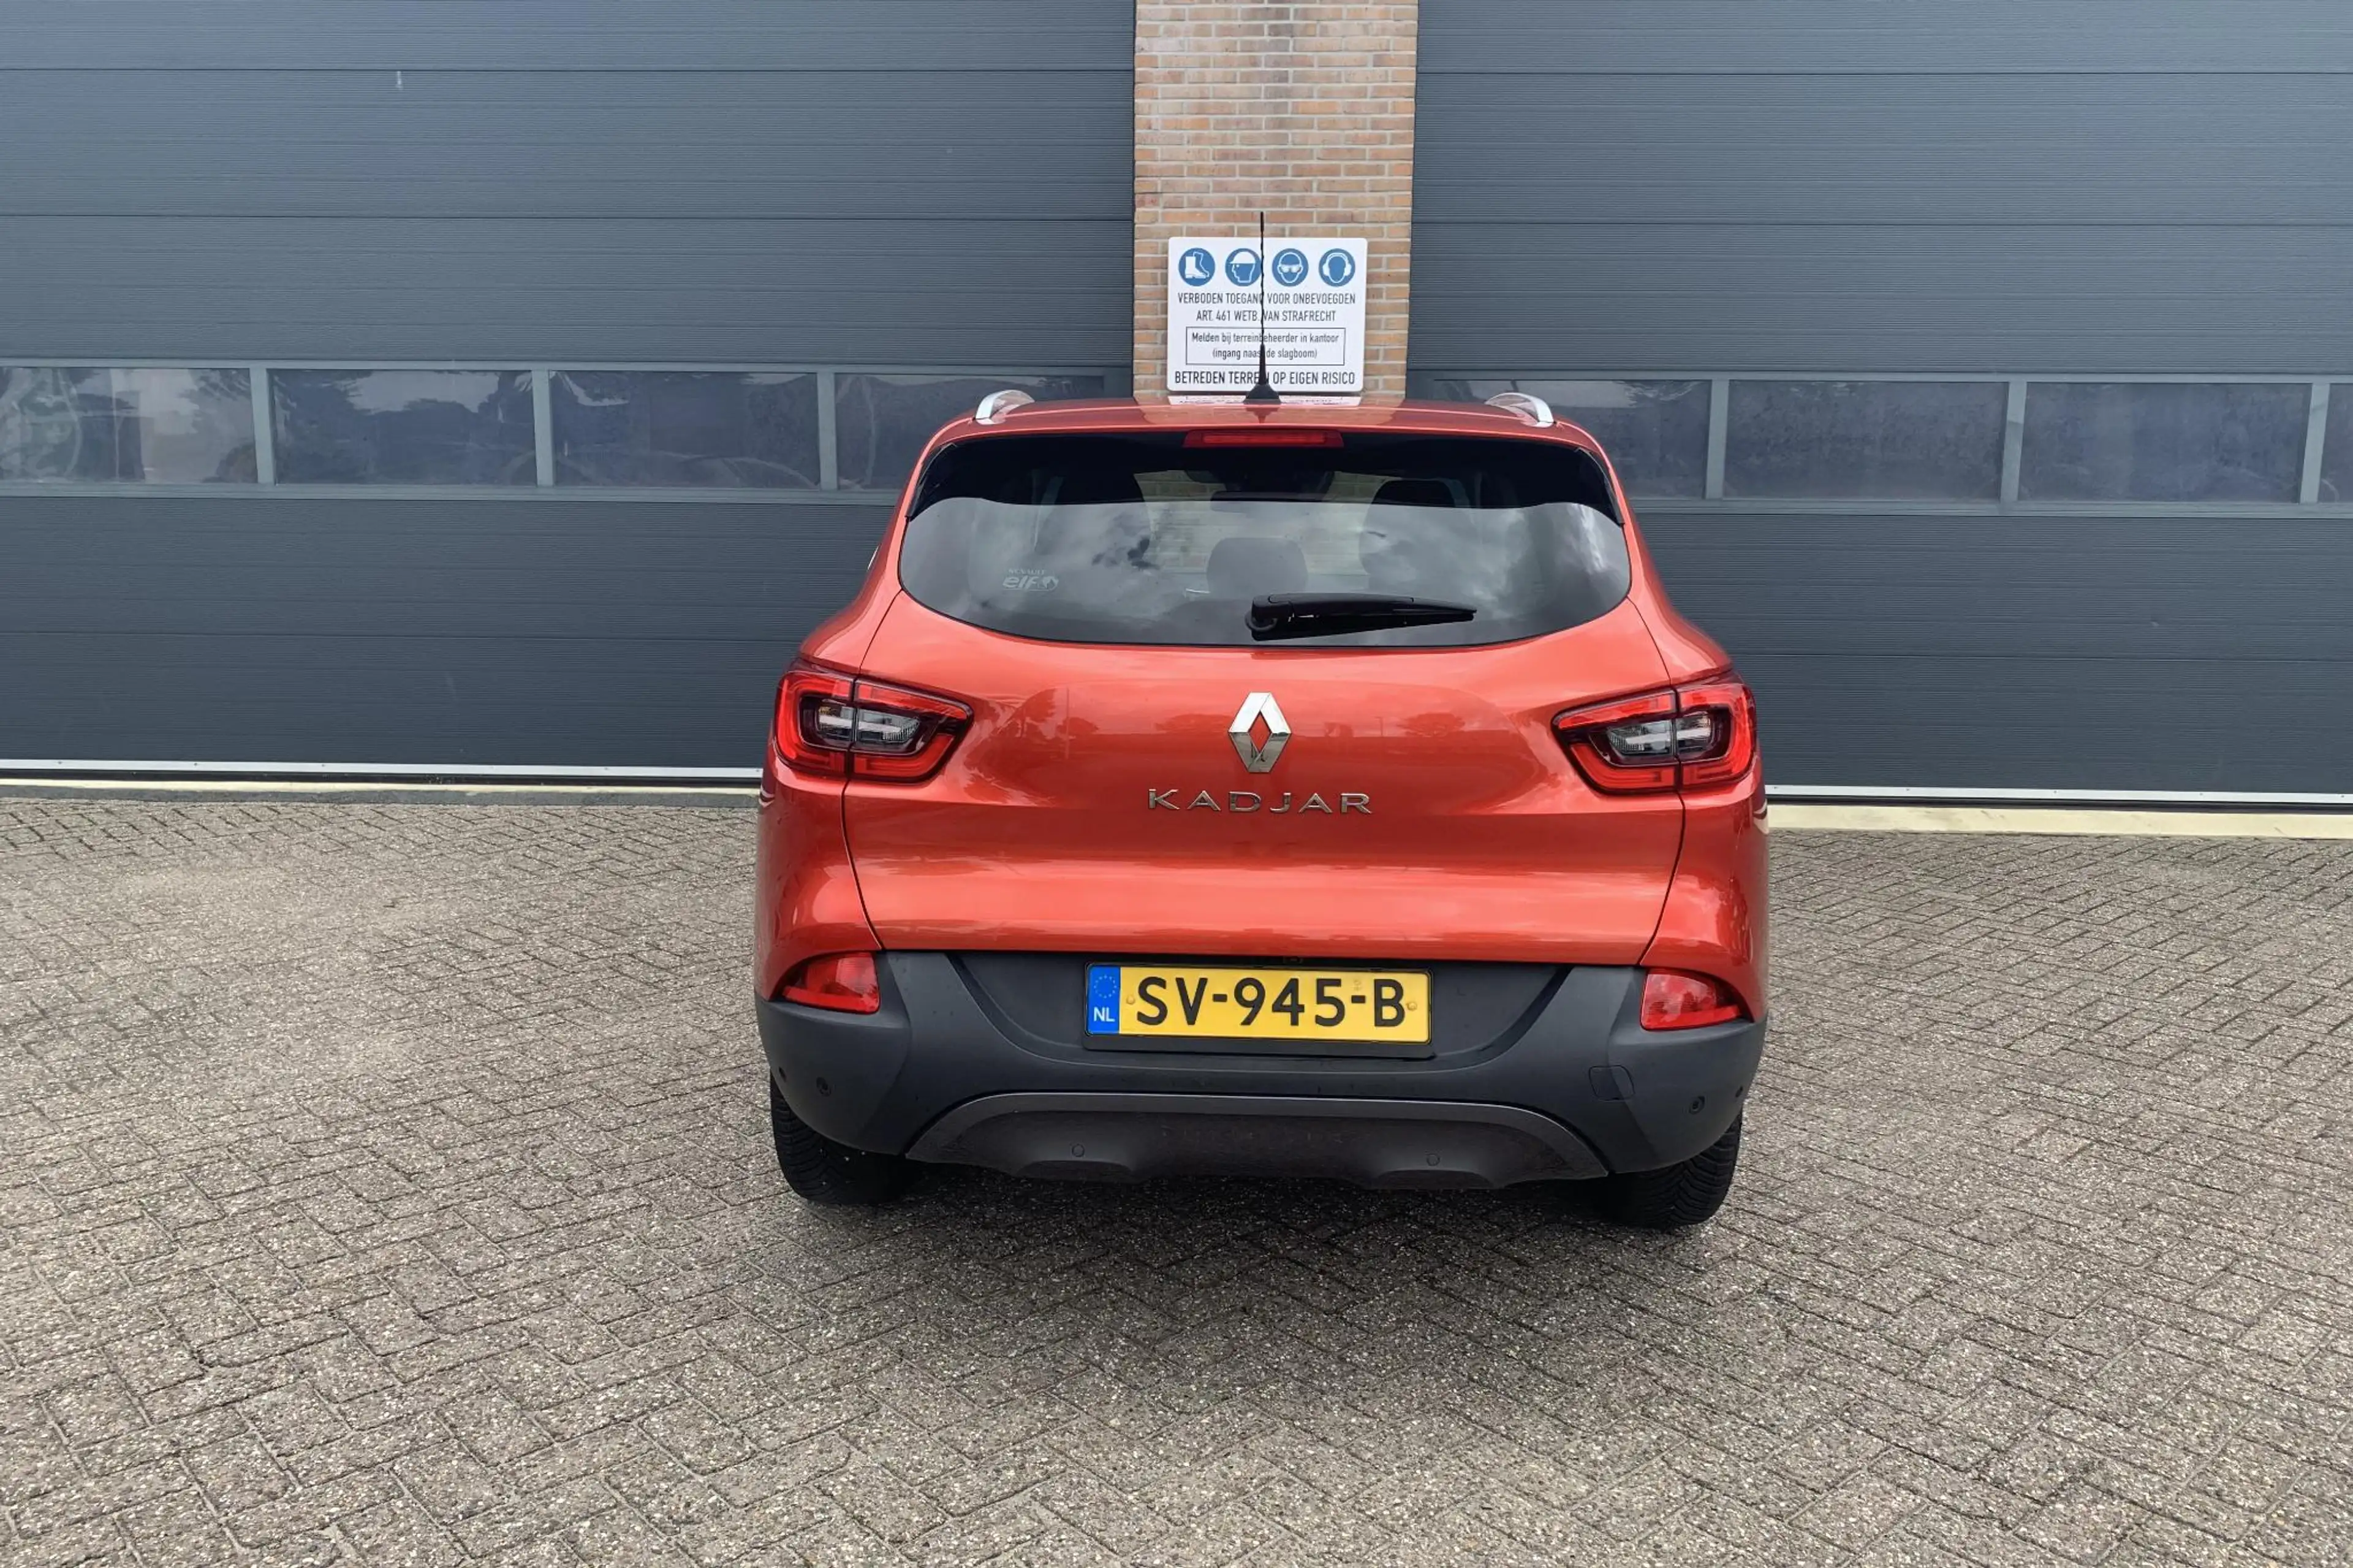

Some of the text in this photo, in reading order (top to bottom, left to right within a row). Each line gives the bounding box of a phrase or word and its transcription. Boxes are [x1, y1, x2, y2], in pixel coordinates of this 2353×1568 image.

[1178, 293, 1223, 304] VERBODEN
[1267, 293, 1290, 304] VOOR
[1293, 293, 1355, 304] ONBEVOEGDEN
[1196, 310, 1213, 321] ART.
[1216, 310, 1230, 321] 461
[1234, 310, 1260, 321] WETB.
[1282, 310, 1336, 322] STRAFRECHT
[1192, 332, 1339, 344] Melden bij terreinbeheerder in kantoor
[1212, 348, 1240, 360] (ingang
[1266, 348, 1275, 358] de
[1278, 348, 1317, 360] slagboom)
[1175, 371, 1225, 384] BETREDEN
[1273, 372, 1286, 384] OP
[1289, 372, 1318, 384] EIGEN
[1322, 372, 1355, 384] RISICO
[1148, 789, 1372, 814] KADJAR
[1094, 977, 1406, 1027] NL SV-945-B
